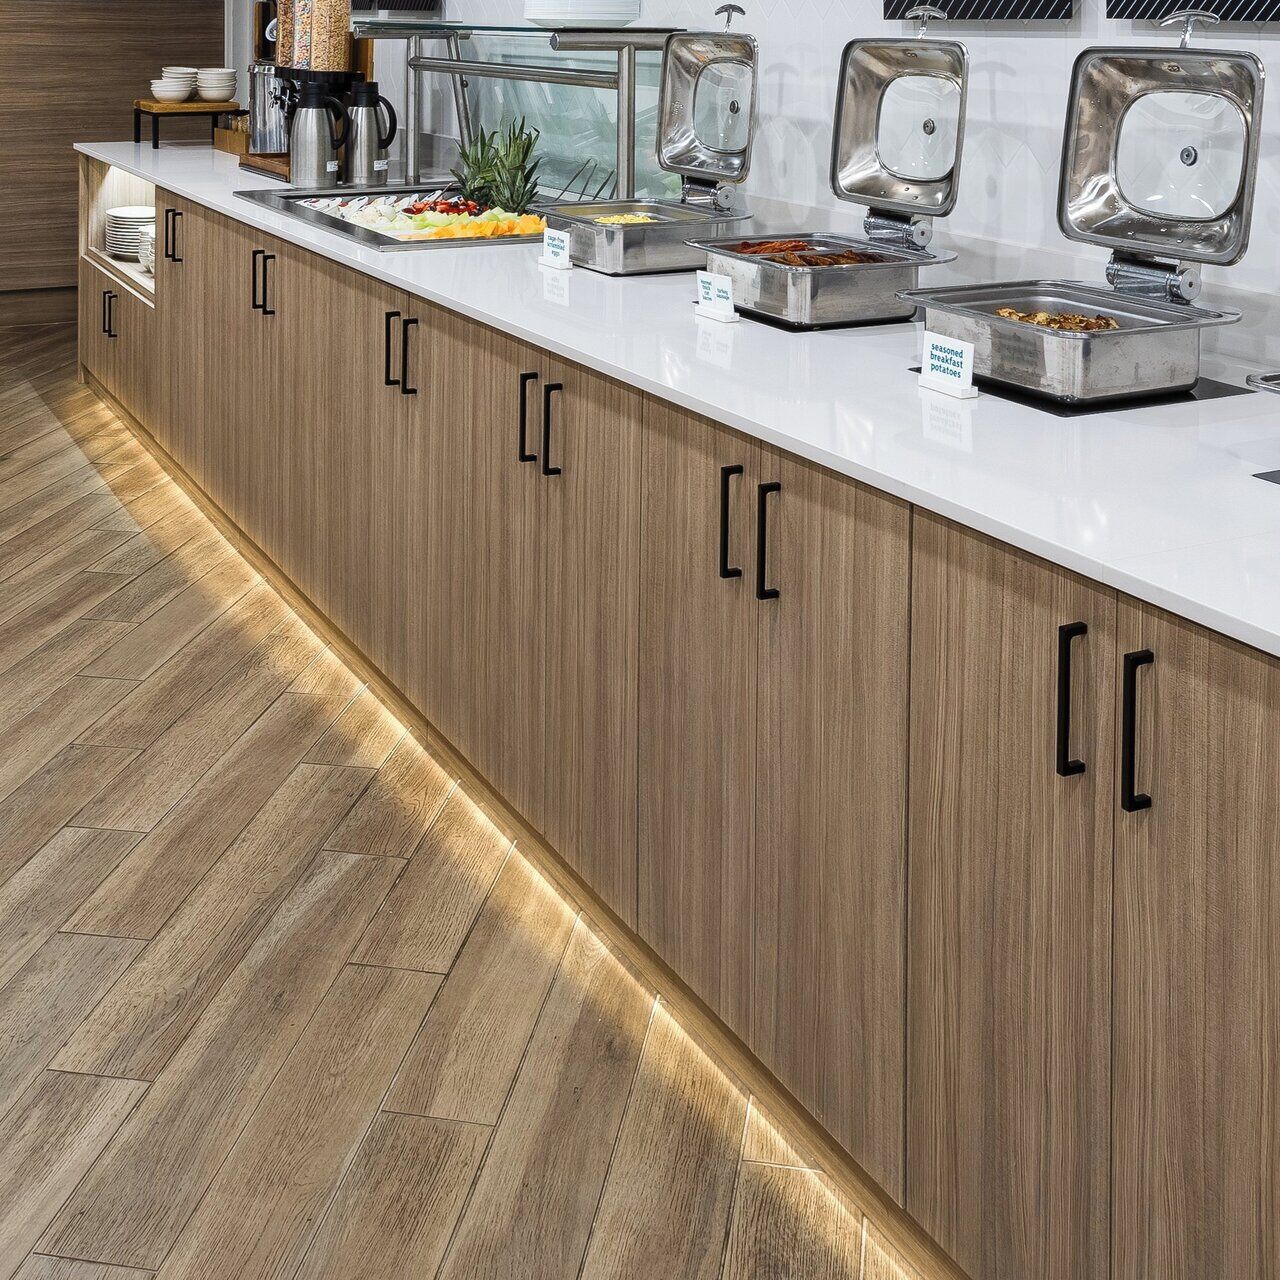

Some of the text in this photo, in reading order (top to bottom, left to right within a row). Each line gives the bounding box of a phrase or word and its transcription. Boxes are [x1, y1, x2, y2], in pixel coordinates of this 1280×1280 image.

[931, 344, 963, 358] seasoned
[930, 350, 963, 369] breakfast
[931, 363, 961, 378] potatoes
